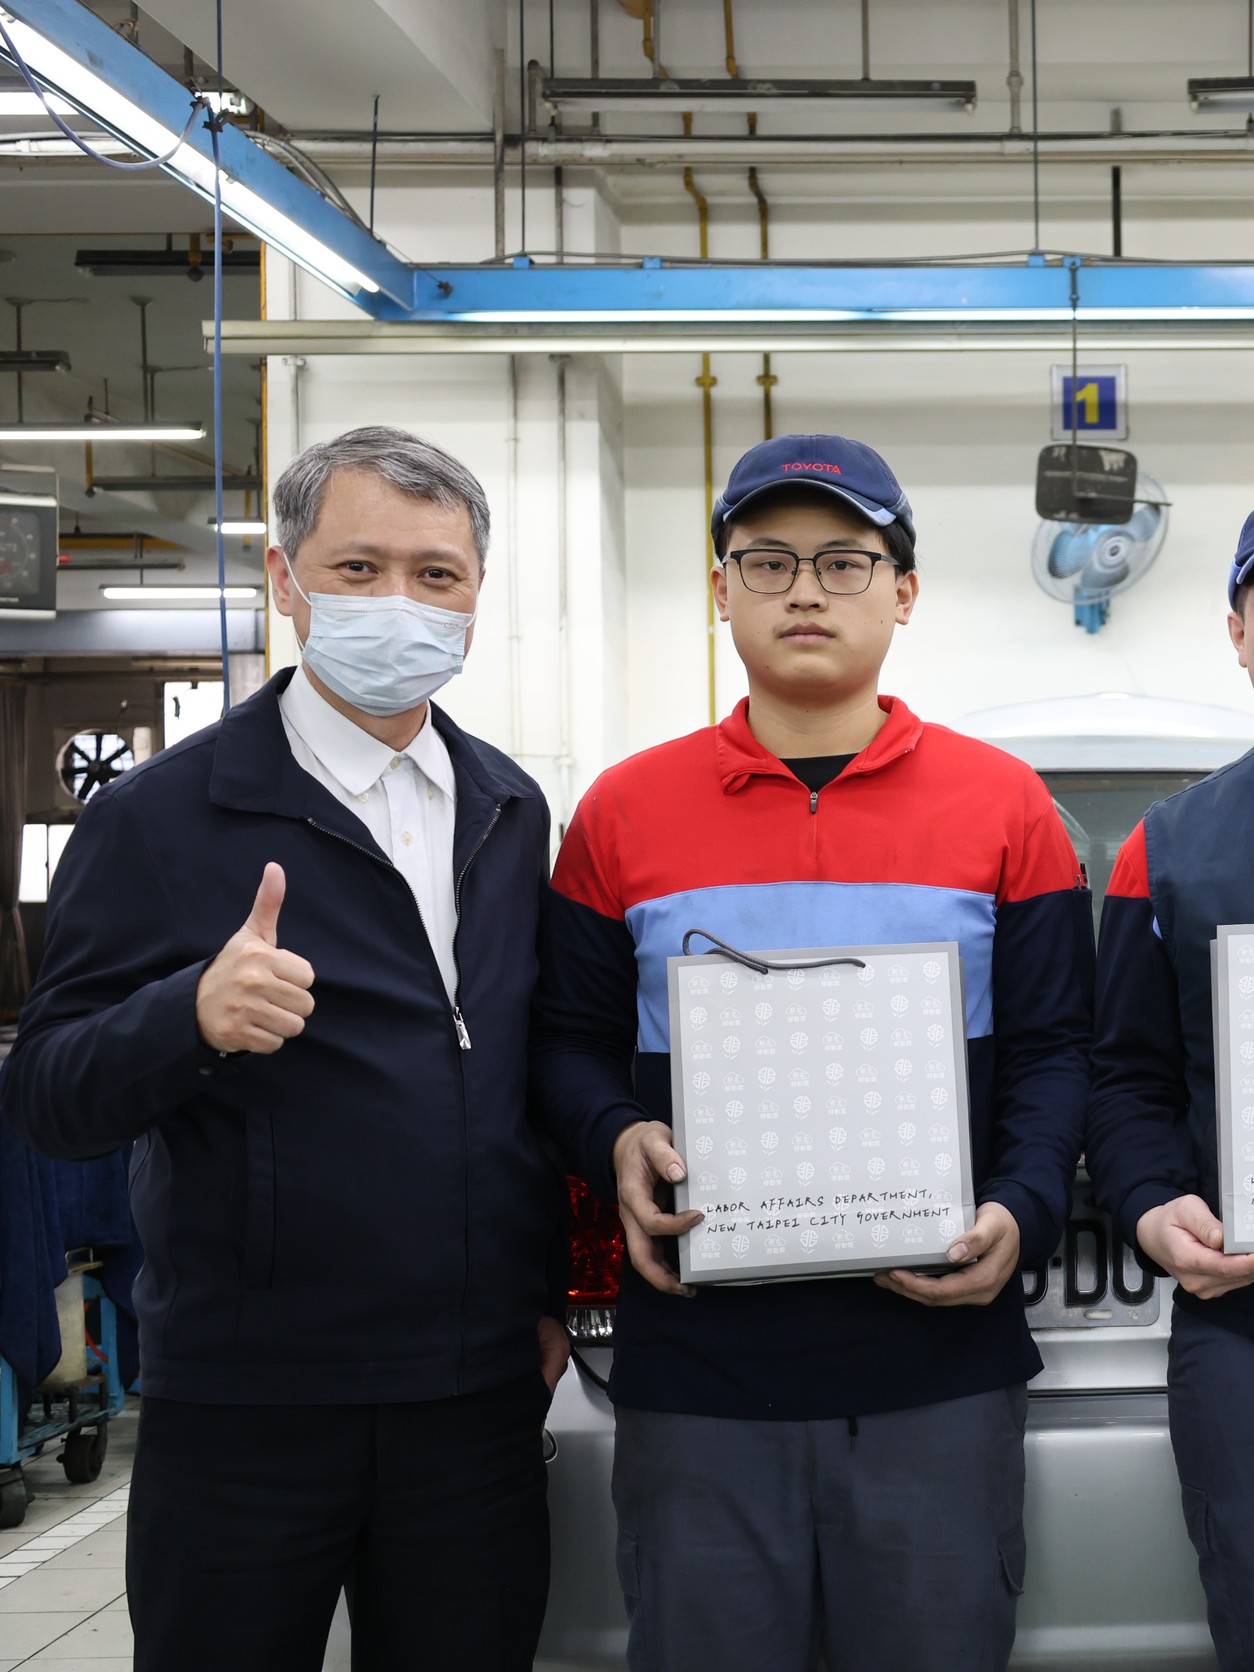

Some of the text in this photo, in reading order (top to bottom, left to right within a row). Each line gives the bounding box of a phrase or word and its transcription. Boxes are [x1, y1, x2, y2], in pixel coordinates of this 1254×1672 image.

[1074, 382, 1099, 424] 1
[780, 462, 843, 476] TOYOTA
[706, 1189, 933, 1214] LABOR AFFAIRS DEPARTMENT,
[706, 1207, 951, 1234] NEW TAIPEI CITY GOVERNMENT
